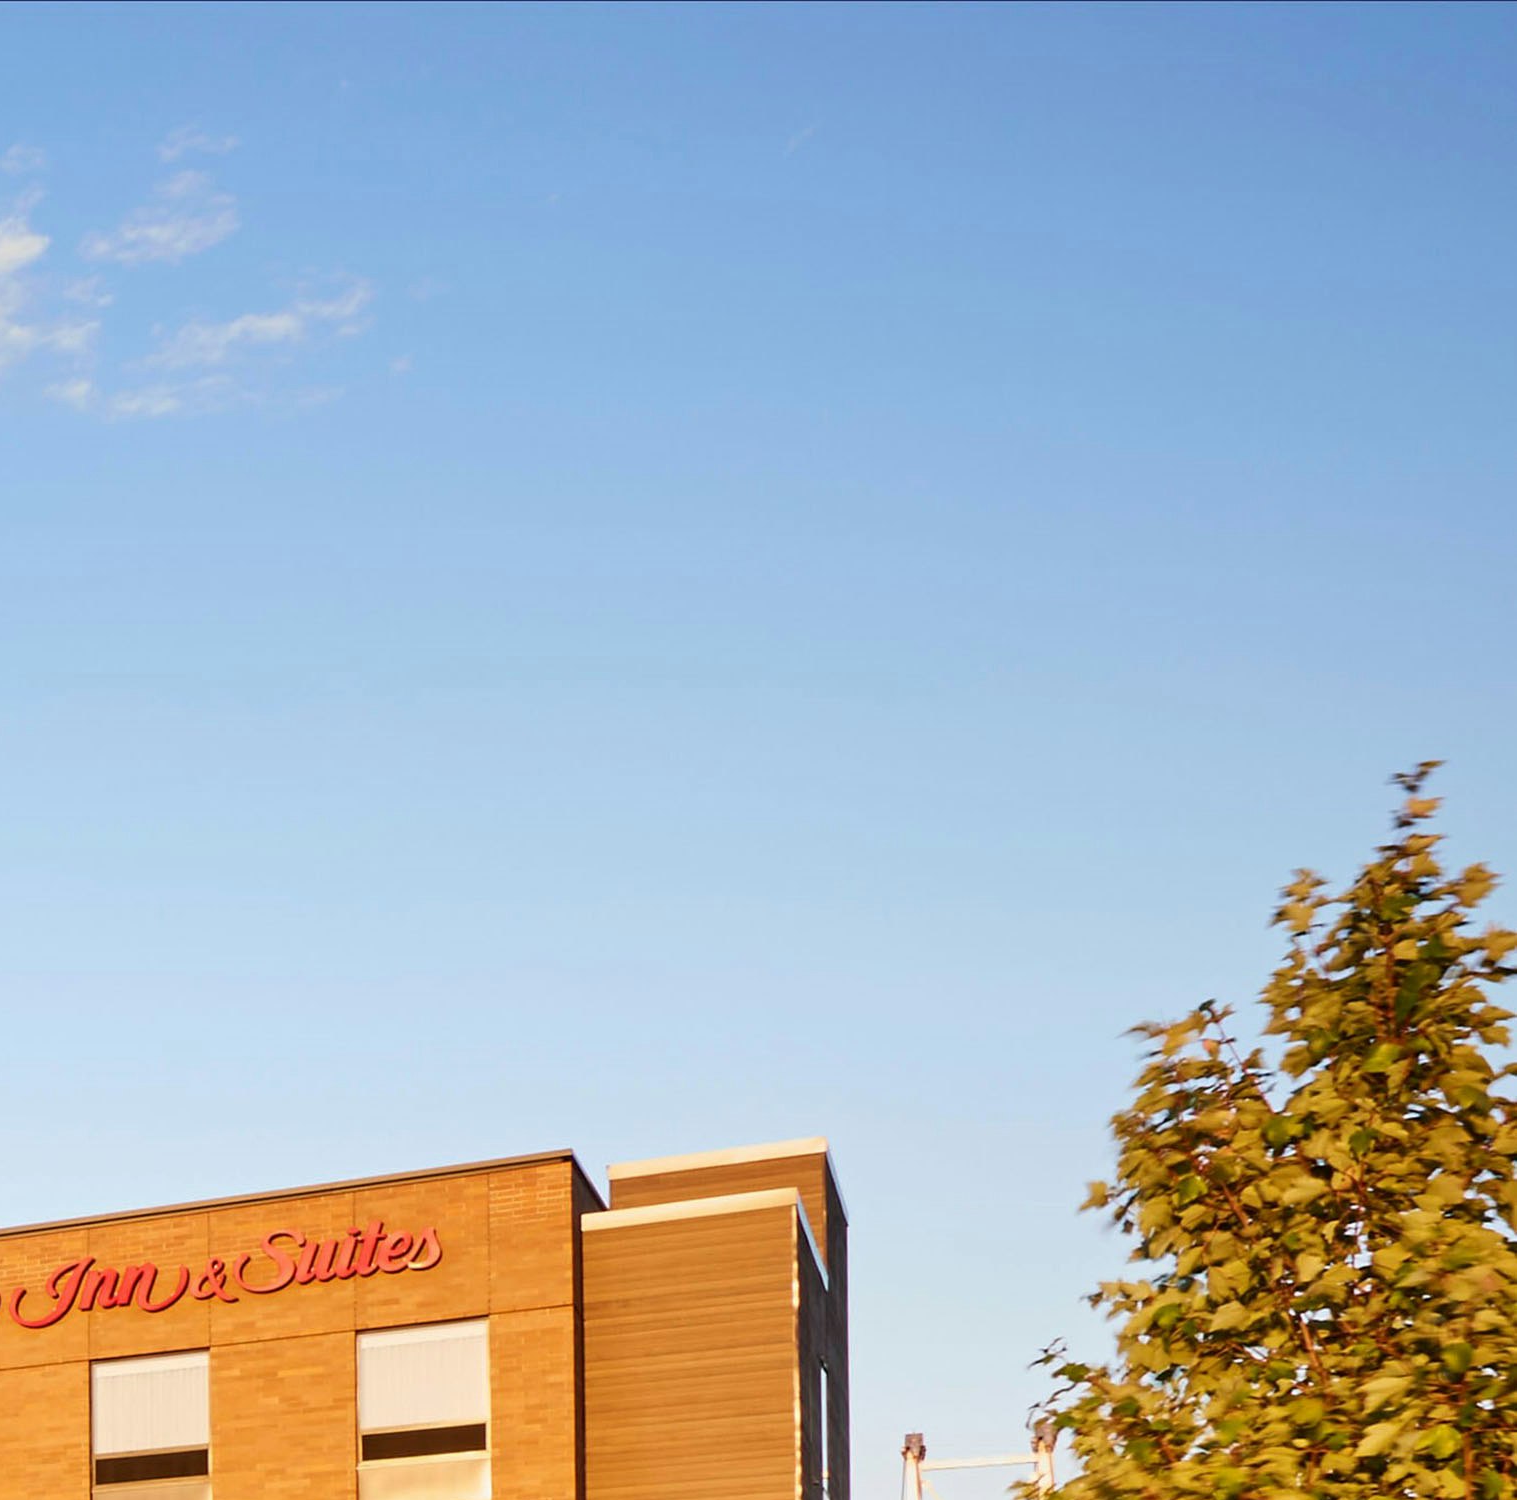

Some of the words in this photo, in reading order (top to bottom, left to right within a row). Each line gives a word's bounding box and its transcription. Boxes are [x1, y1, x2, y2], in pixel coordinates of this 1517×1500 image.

[9, 1256, 191, 1328] Inn
[191, 1257, 240, 1303] &
[233, 1219, 443, 1294] Suites
